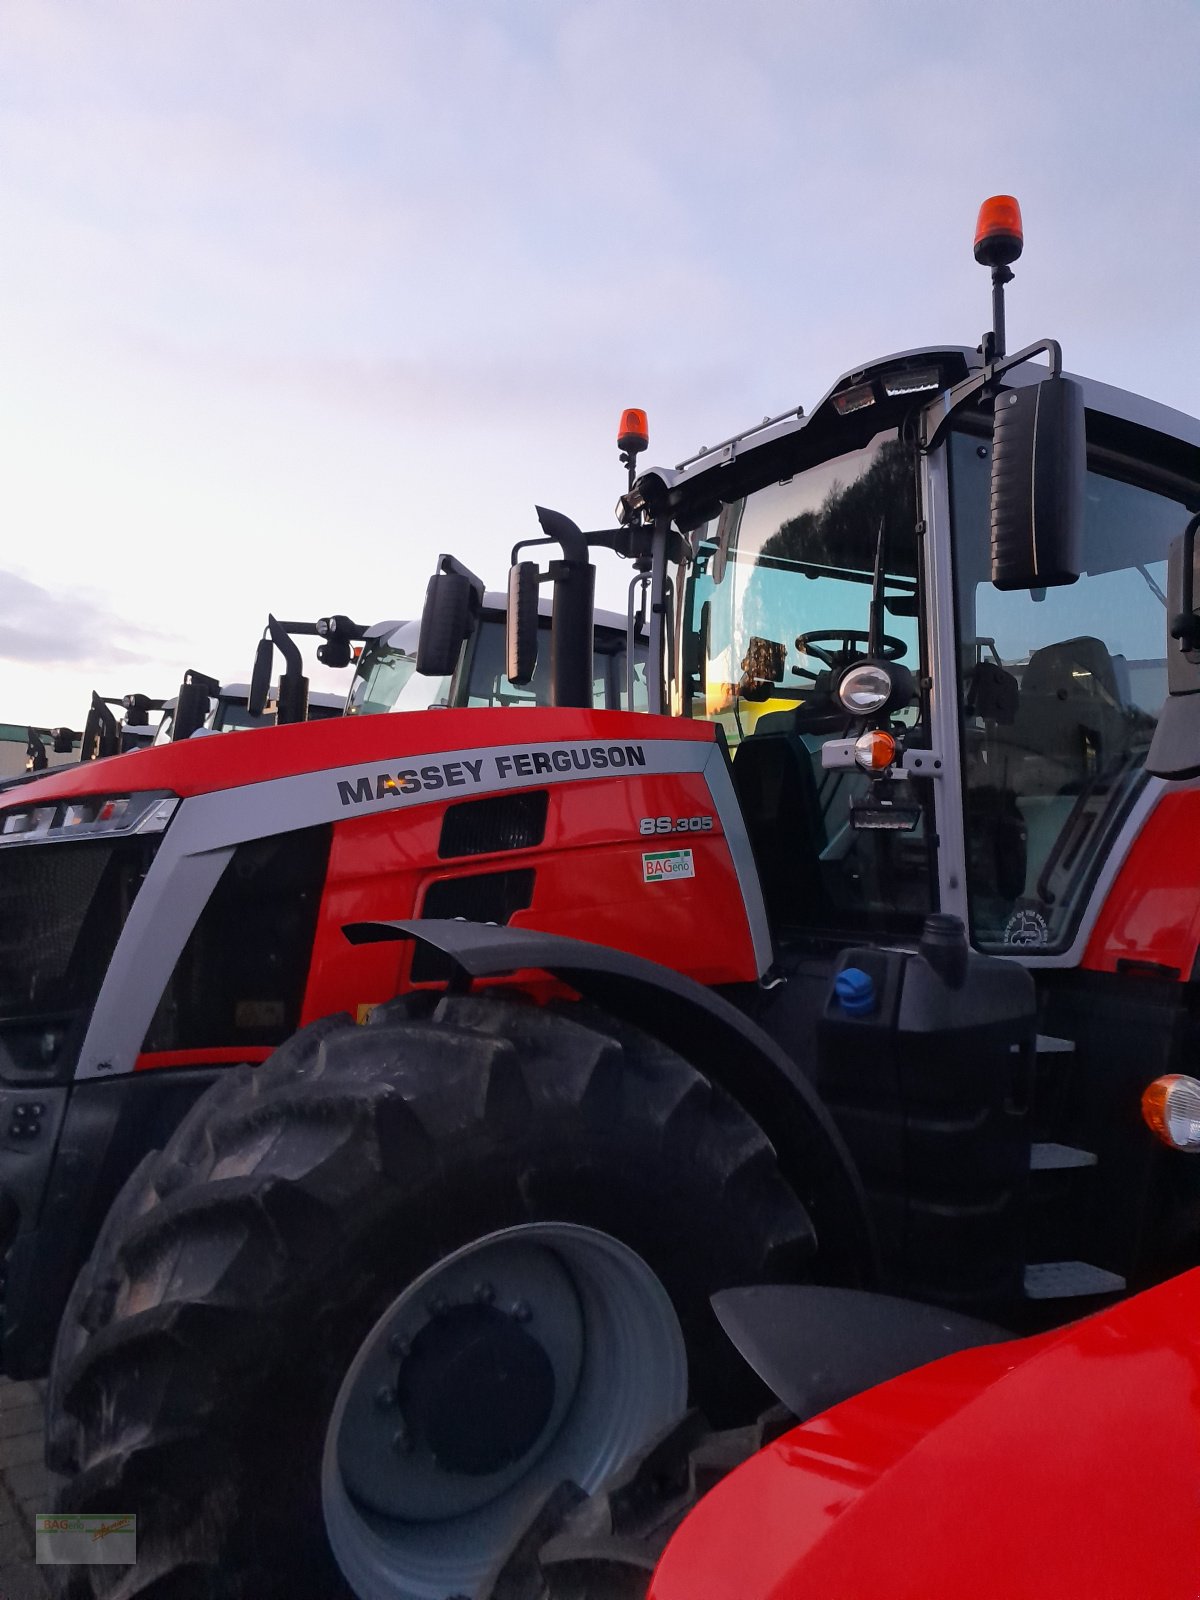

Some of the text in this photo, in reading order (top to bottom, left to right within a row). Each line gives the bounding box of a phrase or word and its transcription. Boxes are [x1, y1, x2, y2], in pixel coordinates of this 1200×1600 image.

[336, 745, 646, 805] MASSEY FERGUSON
[639, 815, 713, 835] 8S.305
[645, 859, 690, 875] BAGeno
